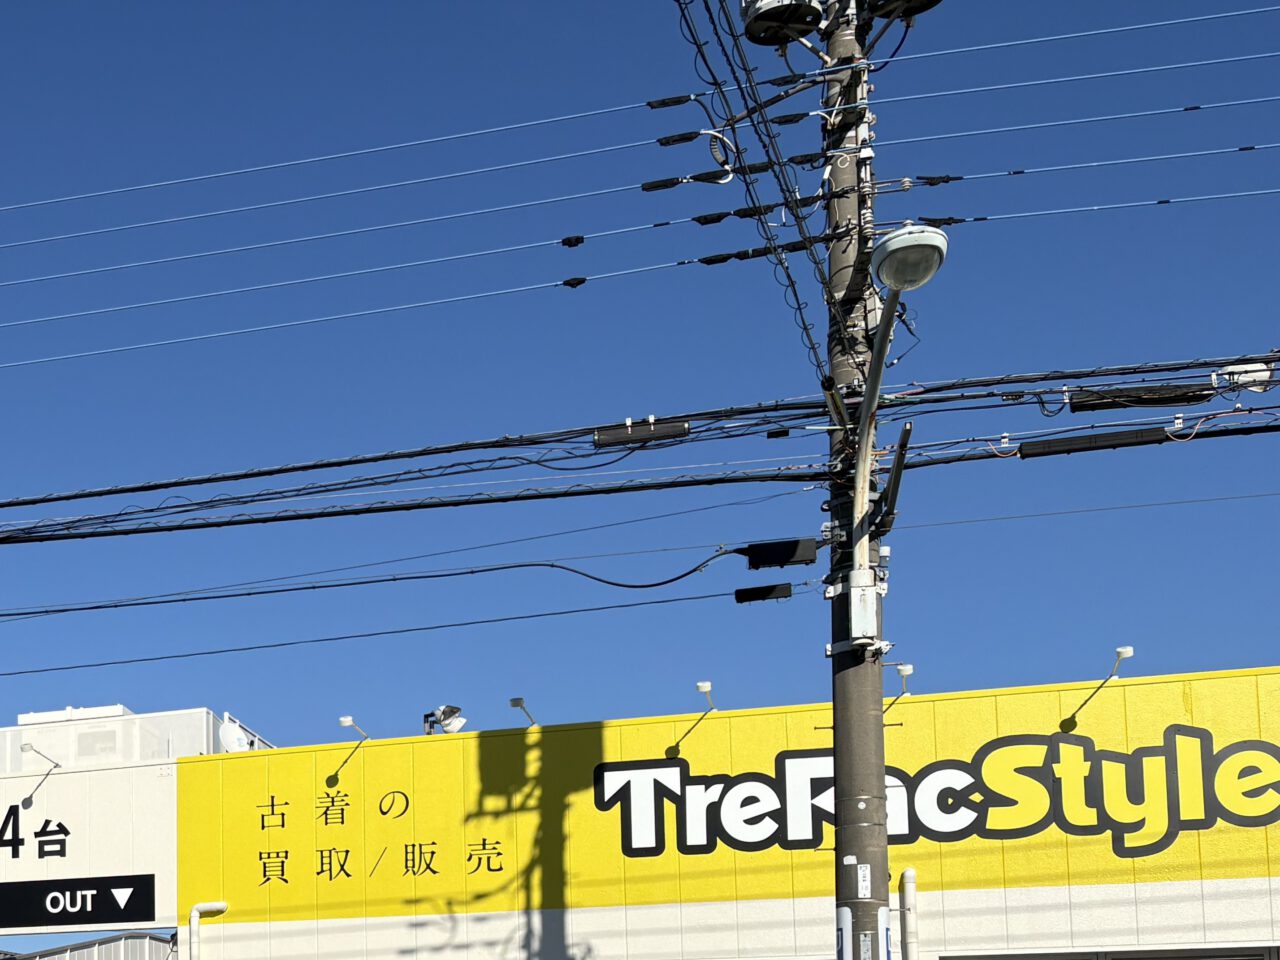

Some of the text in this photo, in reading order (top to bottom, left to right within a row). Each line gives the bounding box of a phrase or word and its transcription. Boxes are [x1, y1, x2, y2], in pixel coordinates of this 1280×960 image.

[256, 790, 410, 831] 古着の
[45, 890, 97, 914] OUT
